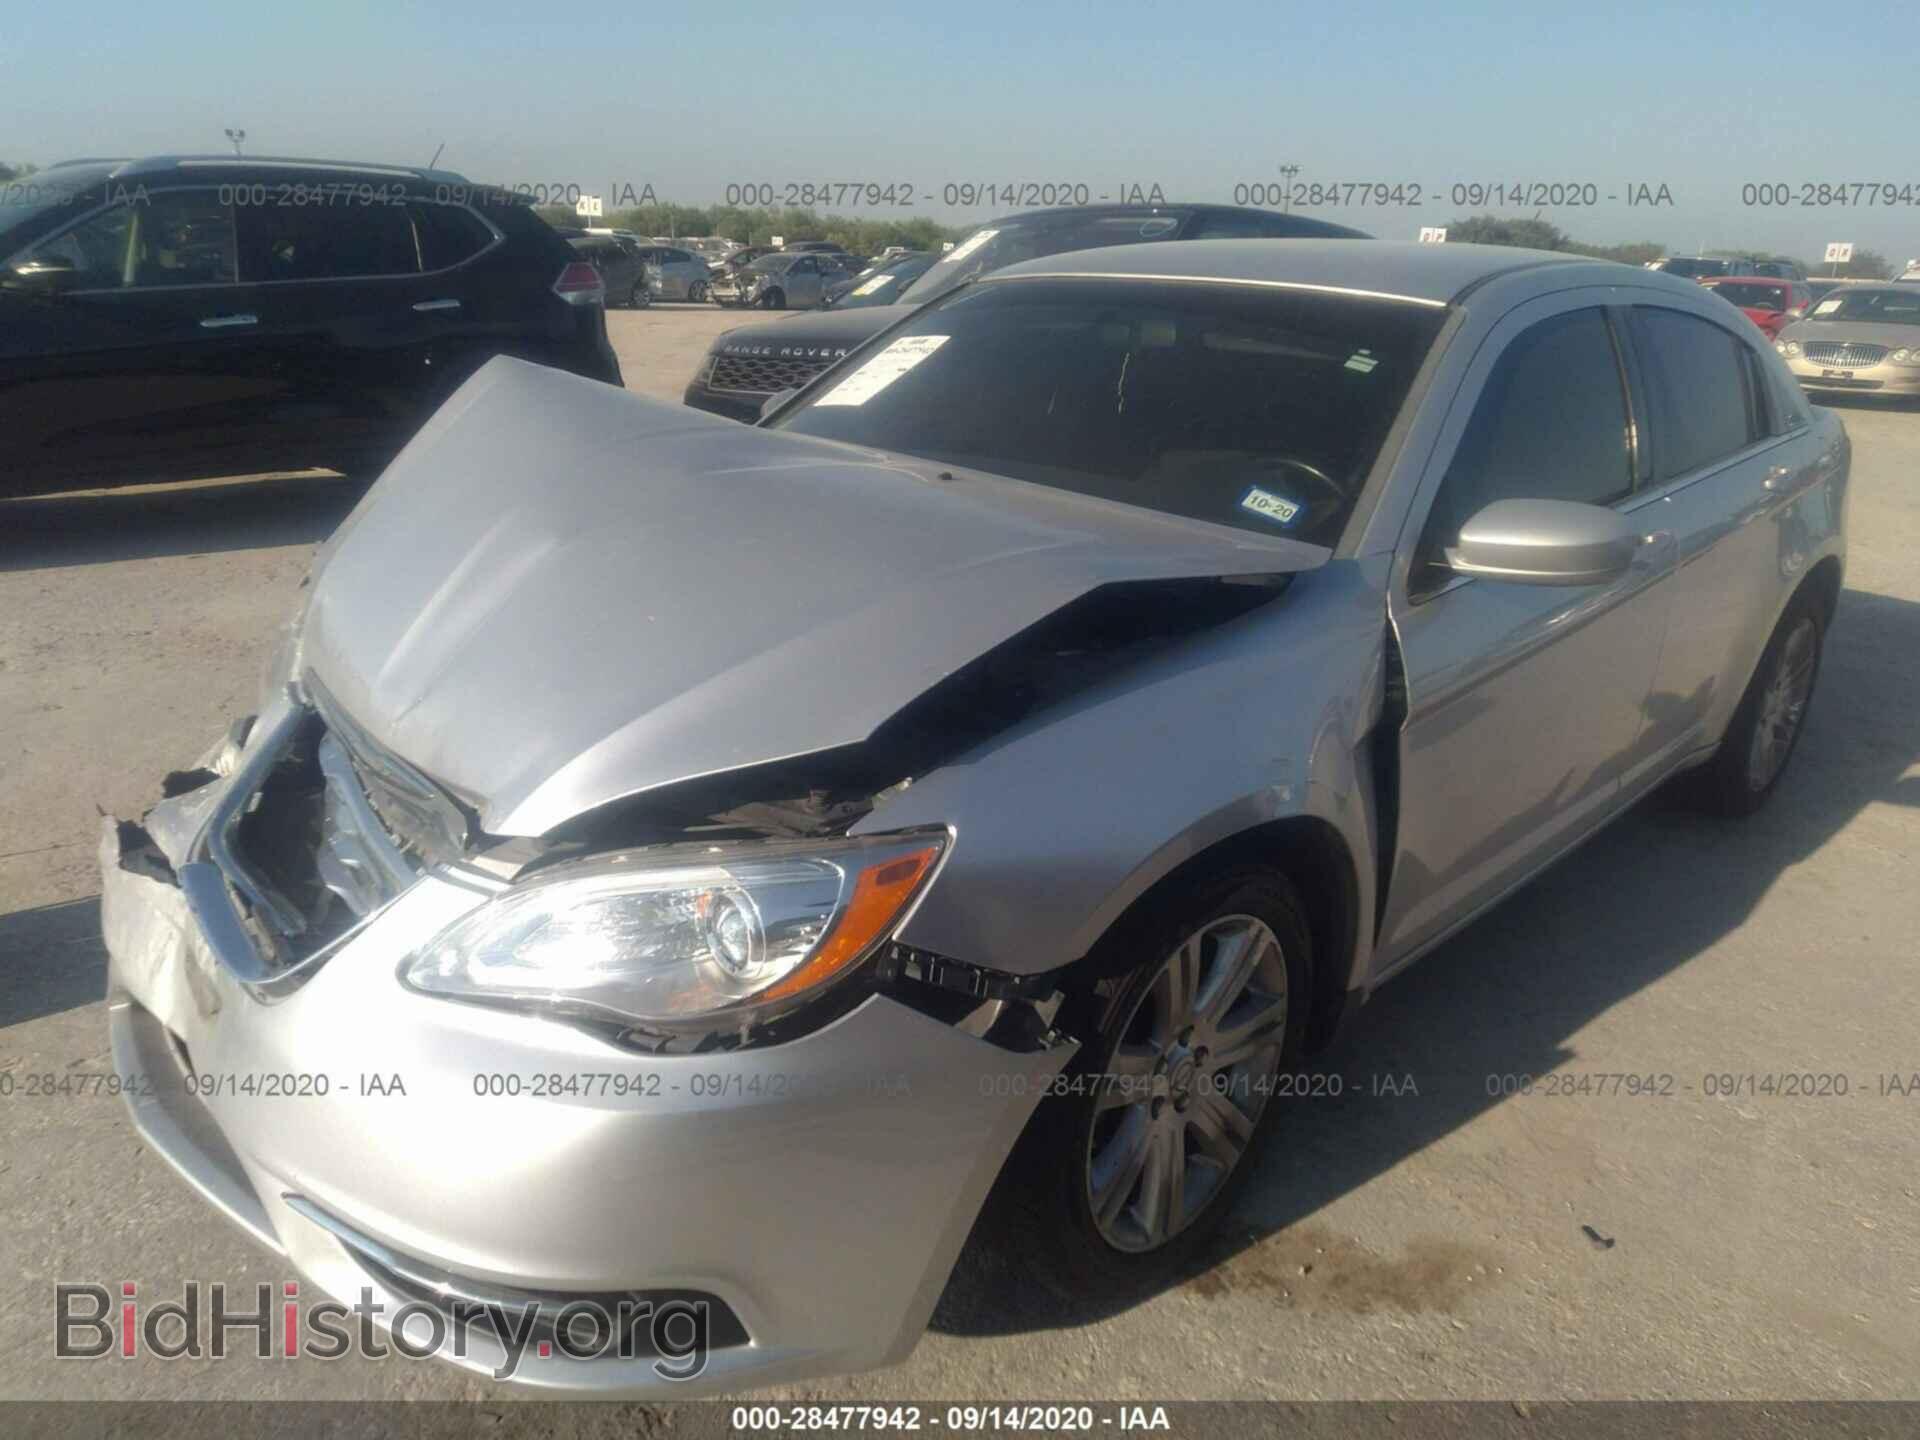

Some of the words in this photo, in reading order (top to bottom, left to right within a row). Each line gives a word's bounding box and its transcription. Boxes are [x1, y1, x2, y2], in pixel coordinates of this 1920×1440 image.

[724, 345, 770, 355] RANGE
[780, 347, 848, 357] ROVER
[1250, 496, 1294, 518] 10-20
